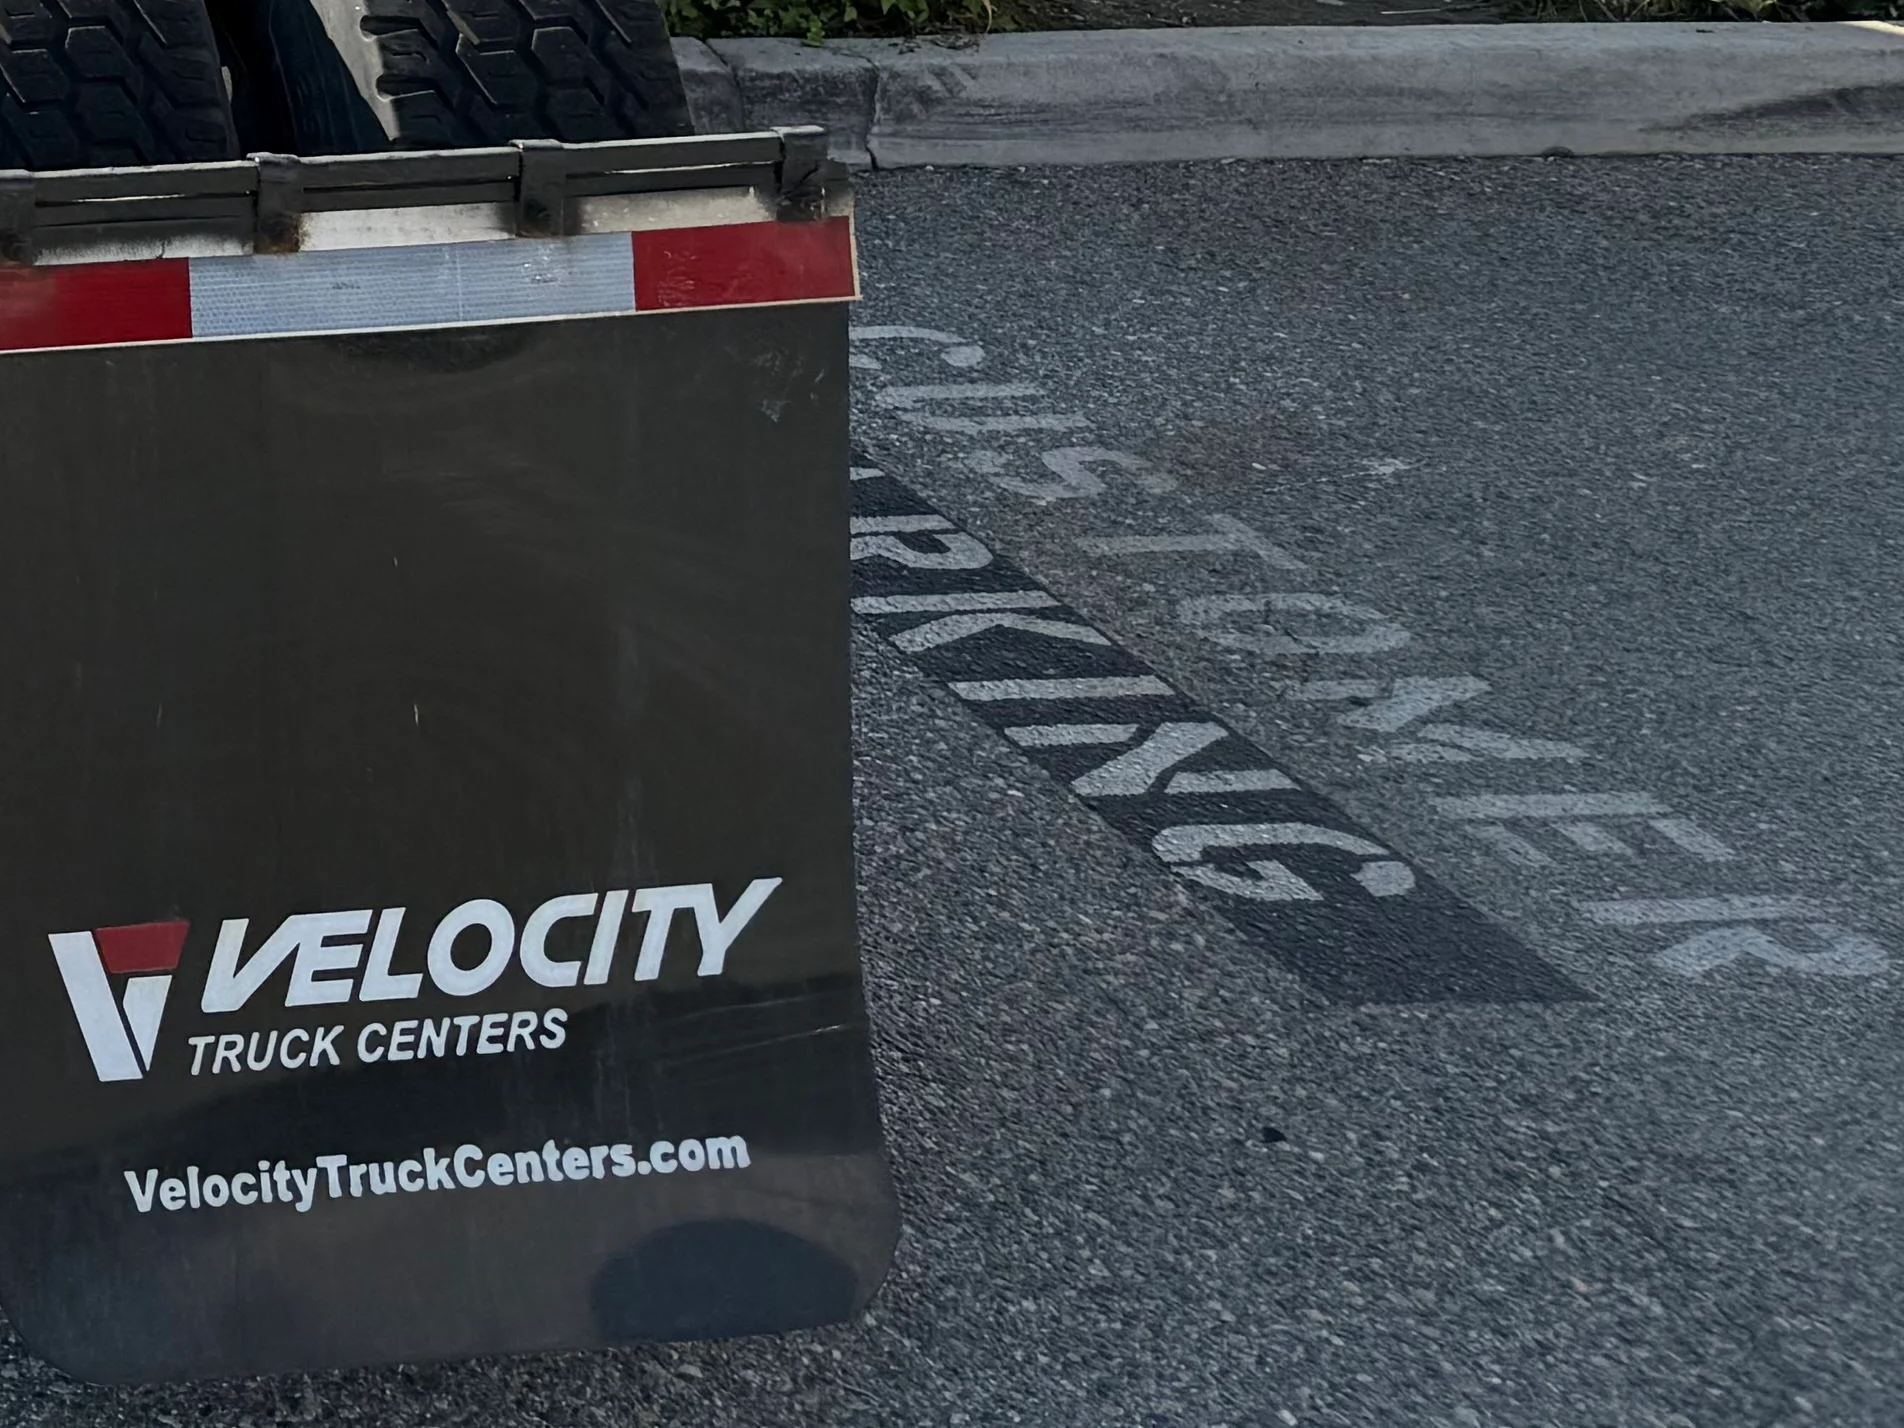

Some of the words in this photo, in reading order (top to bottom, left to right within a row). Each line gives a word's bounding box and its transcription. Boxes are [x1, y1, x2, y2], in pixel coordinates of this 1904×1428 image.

[201, 877, 782, 1013] VELOCITY
[189, 1026, 344, 1075] TRUCK
[358, 1008, 567, 1062] CENTERS
[124, 1136, 751, 1212] VelocityTruckCenters.com
